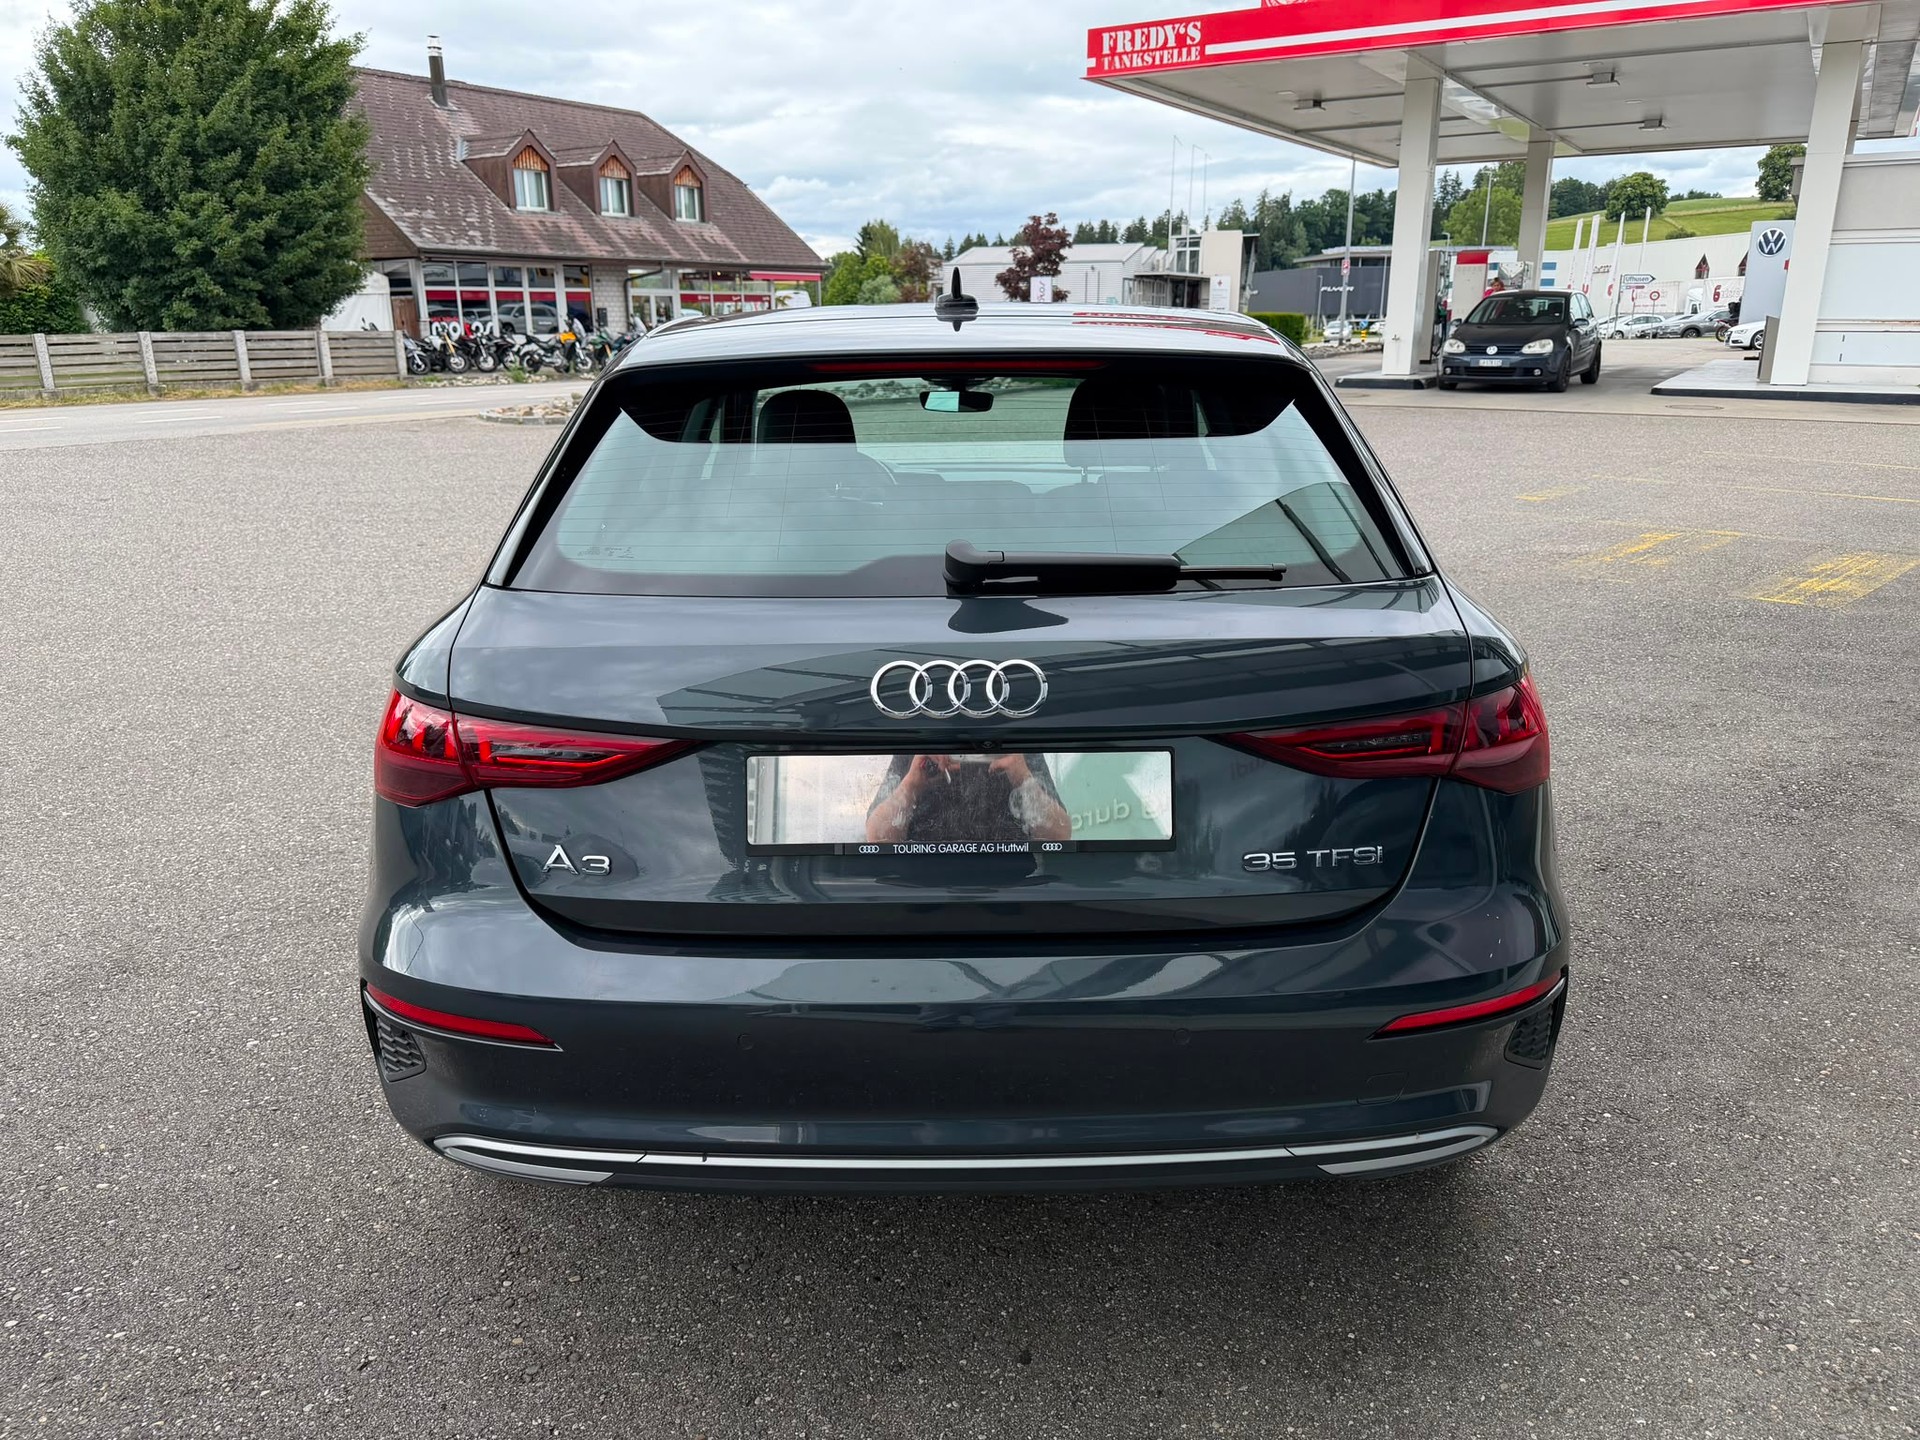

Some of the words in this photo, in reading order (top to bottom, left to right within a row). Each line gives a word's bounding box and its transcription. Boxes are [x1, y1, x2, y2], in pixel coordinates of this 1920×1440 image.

[1101, 46, 1201, 71] TANKSTELLE
[893, 843, 936, 854] TOURING
[938, 843, 978, 854] GARAGE
[980, 843, 995, 853] AG
[996, 842, 1029, 852] Huttwil
[1243, 851, 1298, 872] 35
[1306, 845, 1383, 868] TFSI
